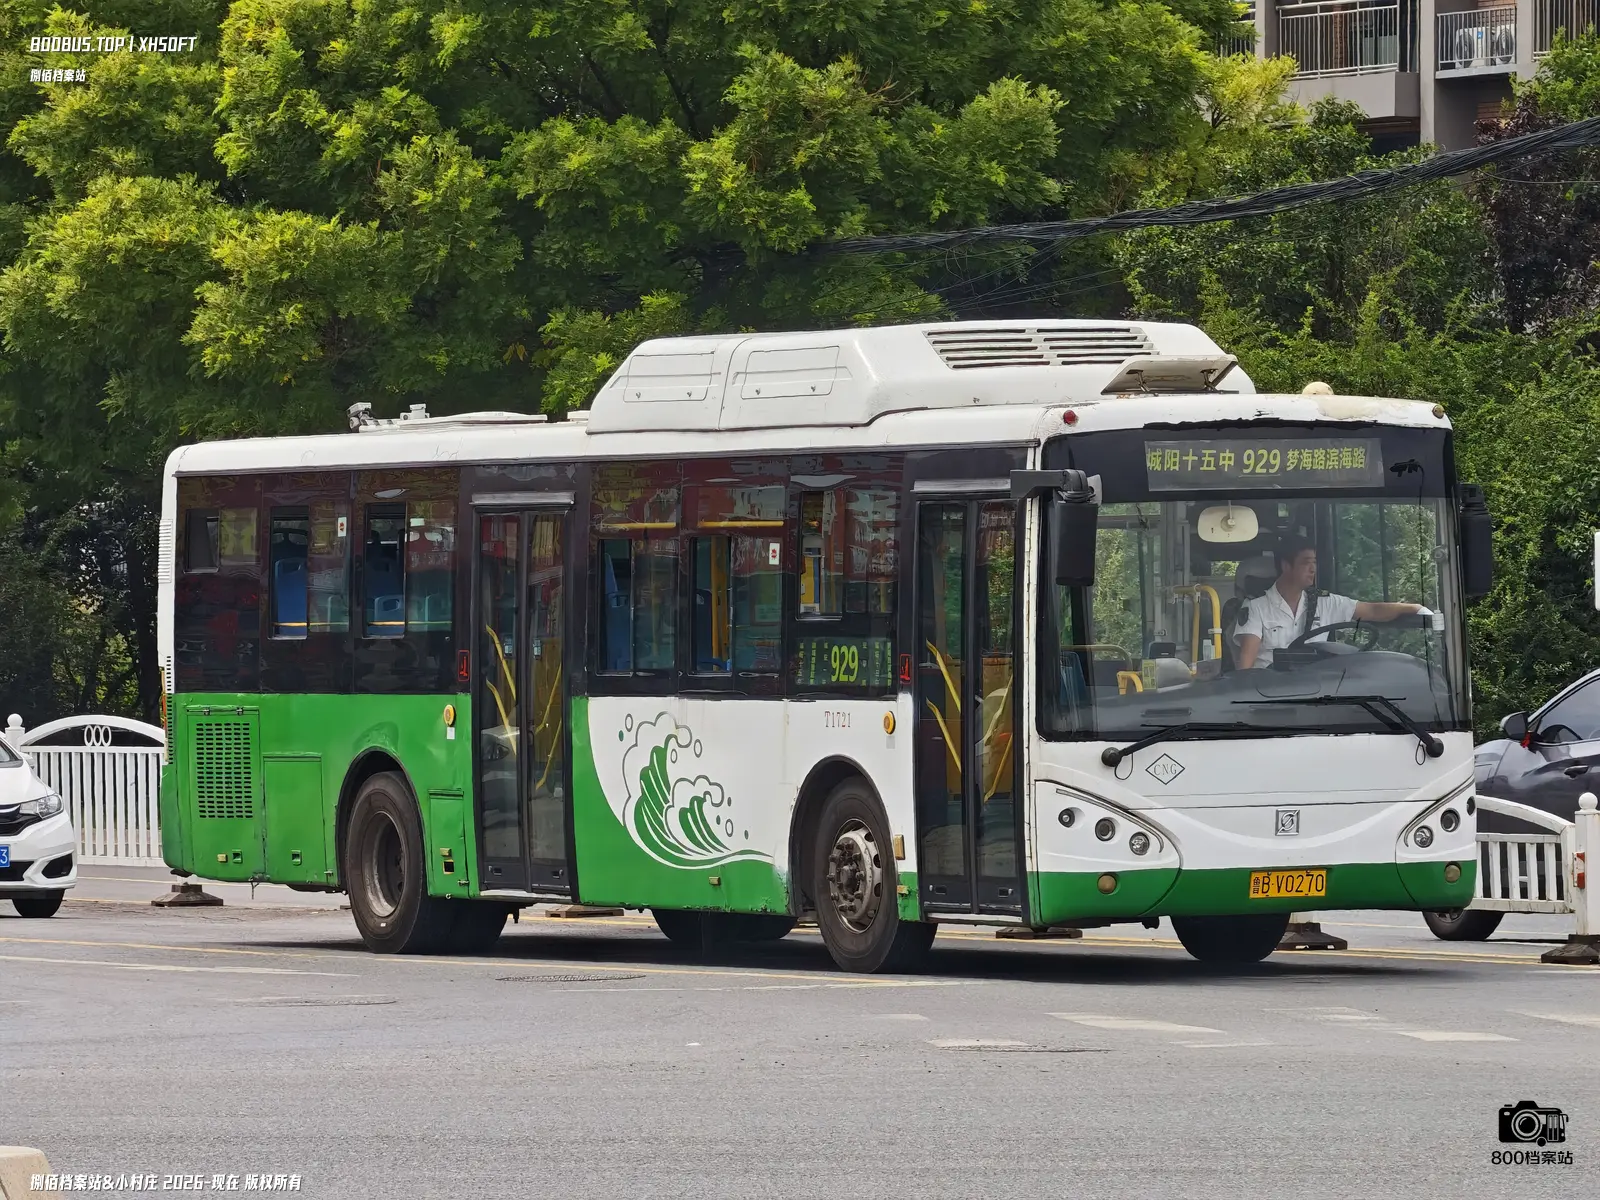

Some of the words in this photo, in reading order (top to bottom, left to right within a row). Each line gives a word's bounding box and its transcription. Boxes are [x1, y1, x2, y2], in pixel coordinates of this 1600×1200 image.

[1147, 448, 1234, 472] 城阳十五中
[1242, 448, 1281, 473] 929
[1286, 446, 1367, 472] 梦海路滨海路
[830, 645, 859, 682] 929
[825, 711, 851, 728] T1721
[1153, 763, 1177, 776] CNG
